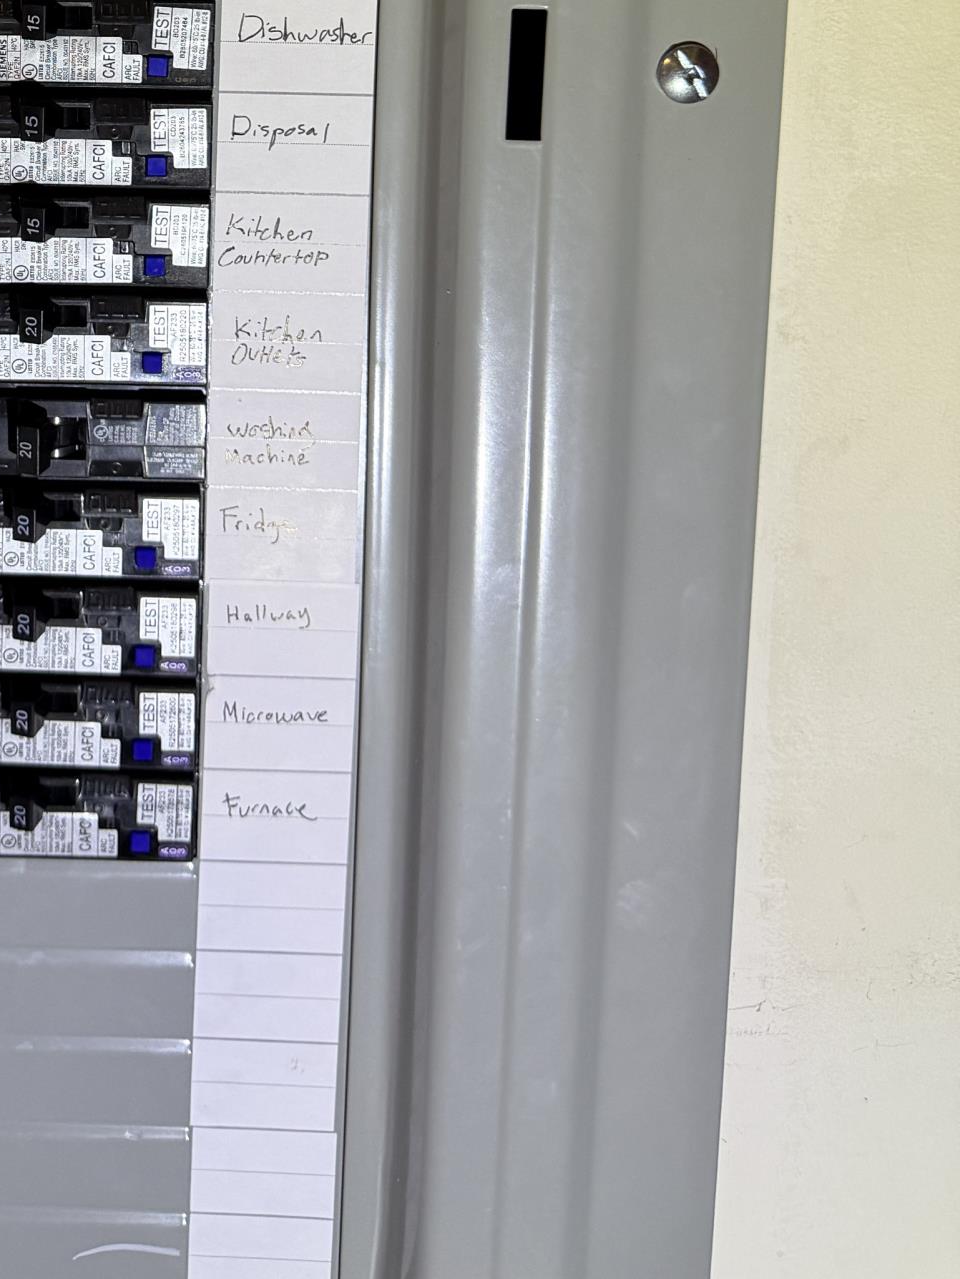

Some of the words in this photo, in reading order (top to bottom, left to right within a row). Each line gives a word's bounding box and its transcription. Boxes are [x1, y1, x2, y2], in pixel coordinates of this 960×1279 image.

[28, 15, 40, 32] 15
[155, 10, 170, 48] TEST
[103, 43, 115, 78] CAFCI
[25, 116, 38, 137] 15
[154, 112, 166, 149] TEST
[231, 115, 329, 151] Disposal
[93, 144, 105, 180] CAFCI
[27, 219, 39, 235] 15
[155, 208, 168, 247] TEST
[226, 213, 313, 241] Kitchen
[94, 243, 105, 278] CAFCI
[218, 246, 329, 267] Countertop
[26, 317, 37, 337] 20
[154, 308, 166, 346] TEST
[235, 315, 322, 344] Kitchen
[92, 341, 103, 376] CAFCI
[121, 357, 129, 378] FAULT
[20, 442, 32, 458] 20
[18, 515, 29, 535] 20
[147, 501, 159, 537] TEST
[84, 534, 95, 570] CAFCI
[18, 615, 29, 634] 20
[145, 600, 156, 636] TEST
[226, 606, 311, 629] Hallway
[82, 633, 94, 667] CAFCI
[16, 710, 28, 730] 20
[143, 695, 155, 731] TEST
[223, 701, 328, 723] Microwave
[81, 727, 93, 761] CAFCI
[14, 806, 25, 825] 20
[142, 786, 154, 820] TEST
[223, 792, 318, 821] Furnace
[79, 819, 92, 851] CAFCI
